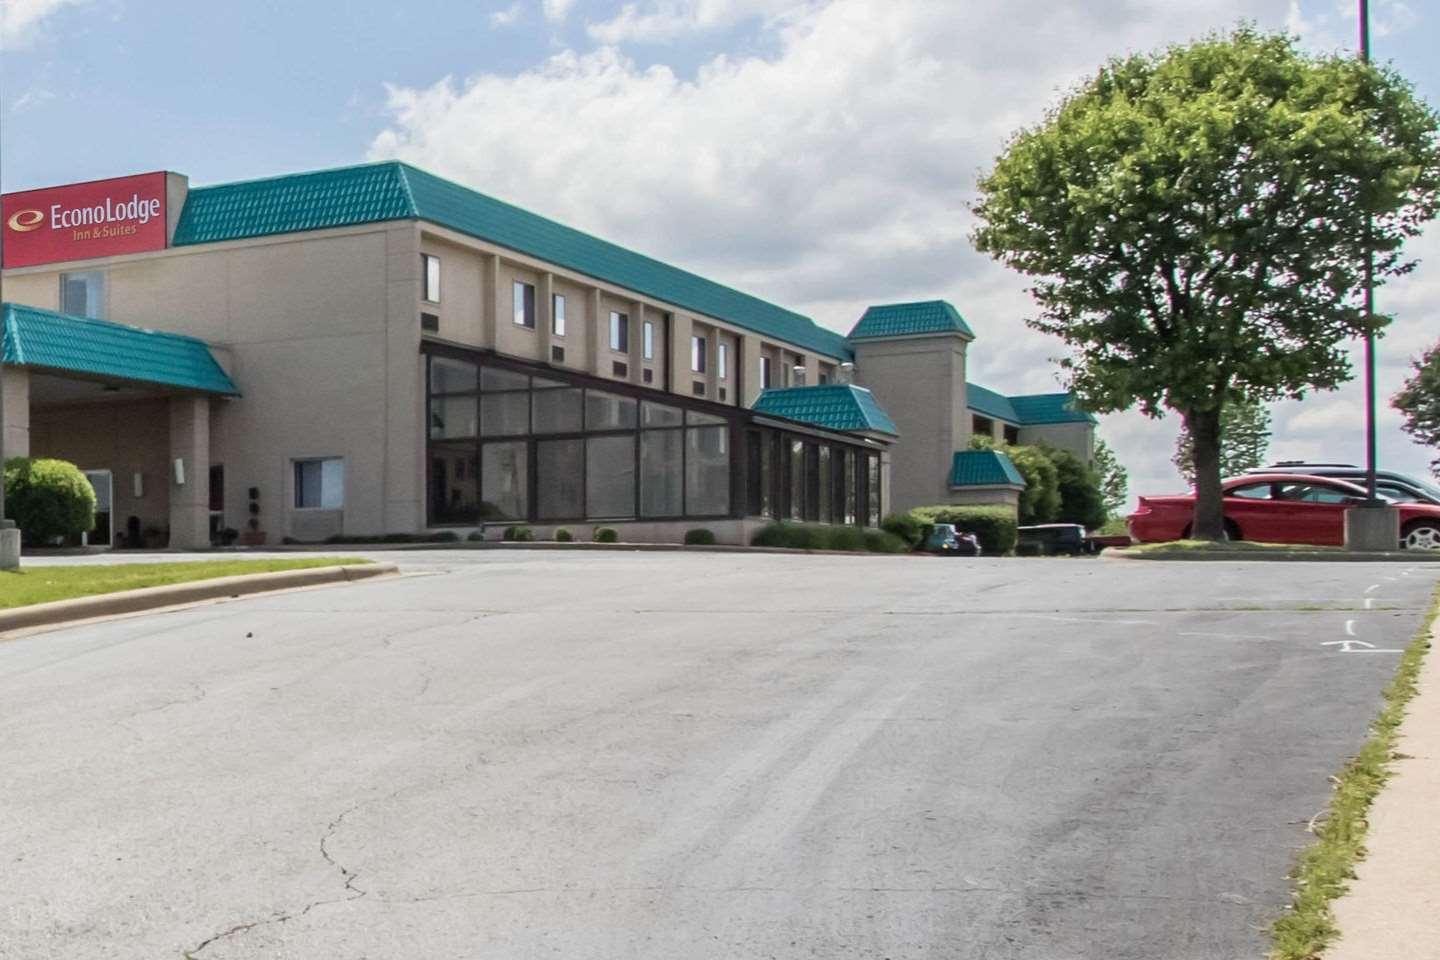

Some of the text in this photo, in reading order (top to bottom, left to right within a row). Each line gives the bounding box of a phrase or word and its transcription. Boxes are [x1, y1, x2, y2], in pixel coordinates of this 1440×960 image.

[51, 193, 160, 229] EconoLodge
[73, 224, 136, 240] Inn & Suites
